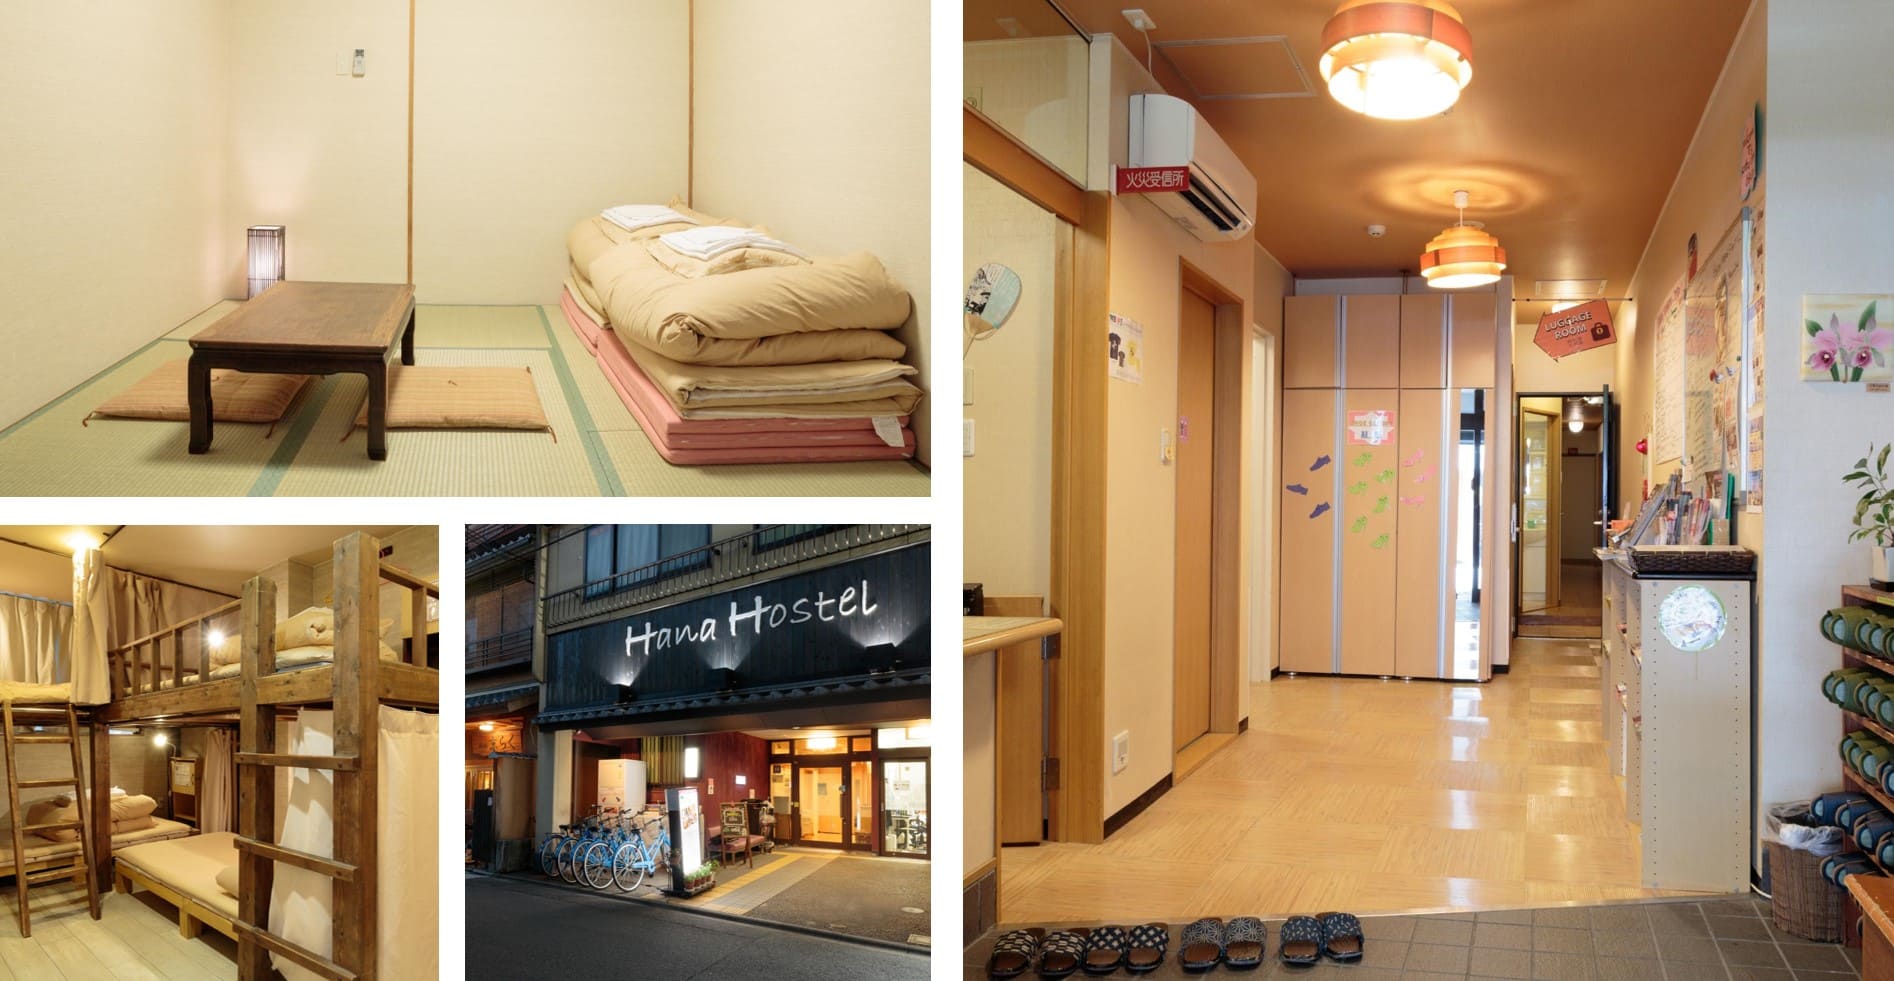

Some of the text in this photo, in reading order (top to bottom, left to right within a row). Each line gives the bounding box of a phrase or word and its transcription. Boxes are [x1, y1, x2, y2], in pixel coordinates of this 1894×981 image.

[1126, 170, 1185, 189] 火災受信所
[1545, 311, 1593, 332] LUGGAGE
[1554, 323, 1587, 340] ROOM
[625, 579, 878, 657] Hana Hostel
